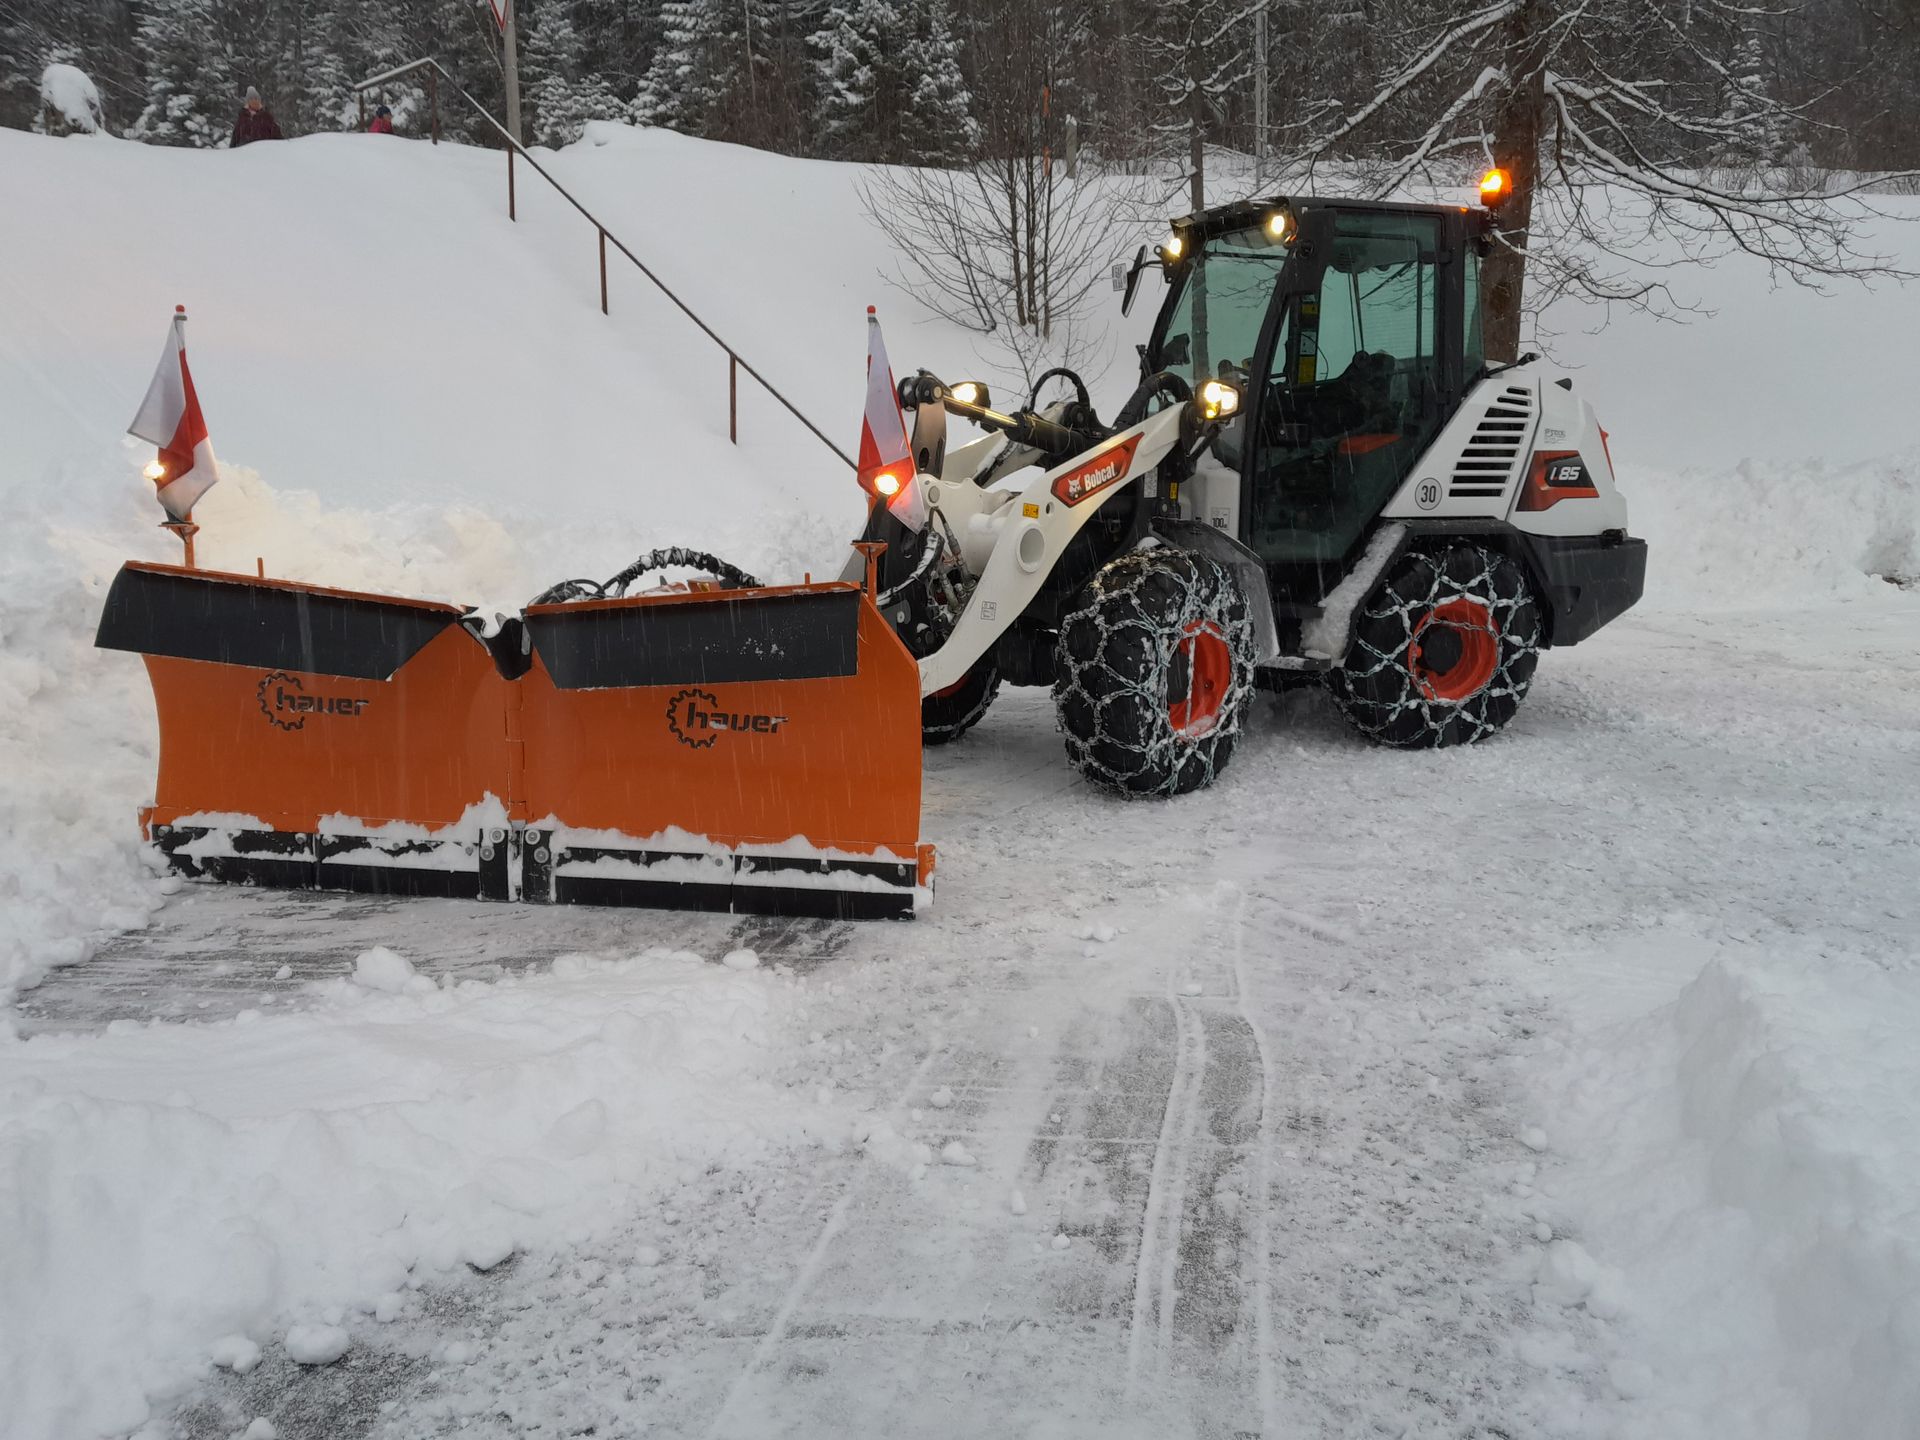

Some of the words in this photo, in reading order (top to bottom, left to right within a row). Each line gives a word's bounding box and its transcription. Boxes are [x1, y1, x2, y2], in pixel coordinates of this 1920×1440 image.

[1084, 461, 1116, 491] Bobcat
[1420, 485, 1437, 503] 30
[276, 686, 369, 716] hauer
[687, 702, 788, 733] hauer
